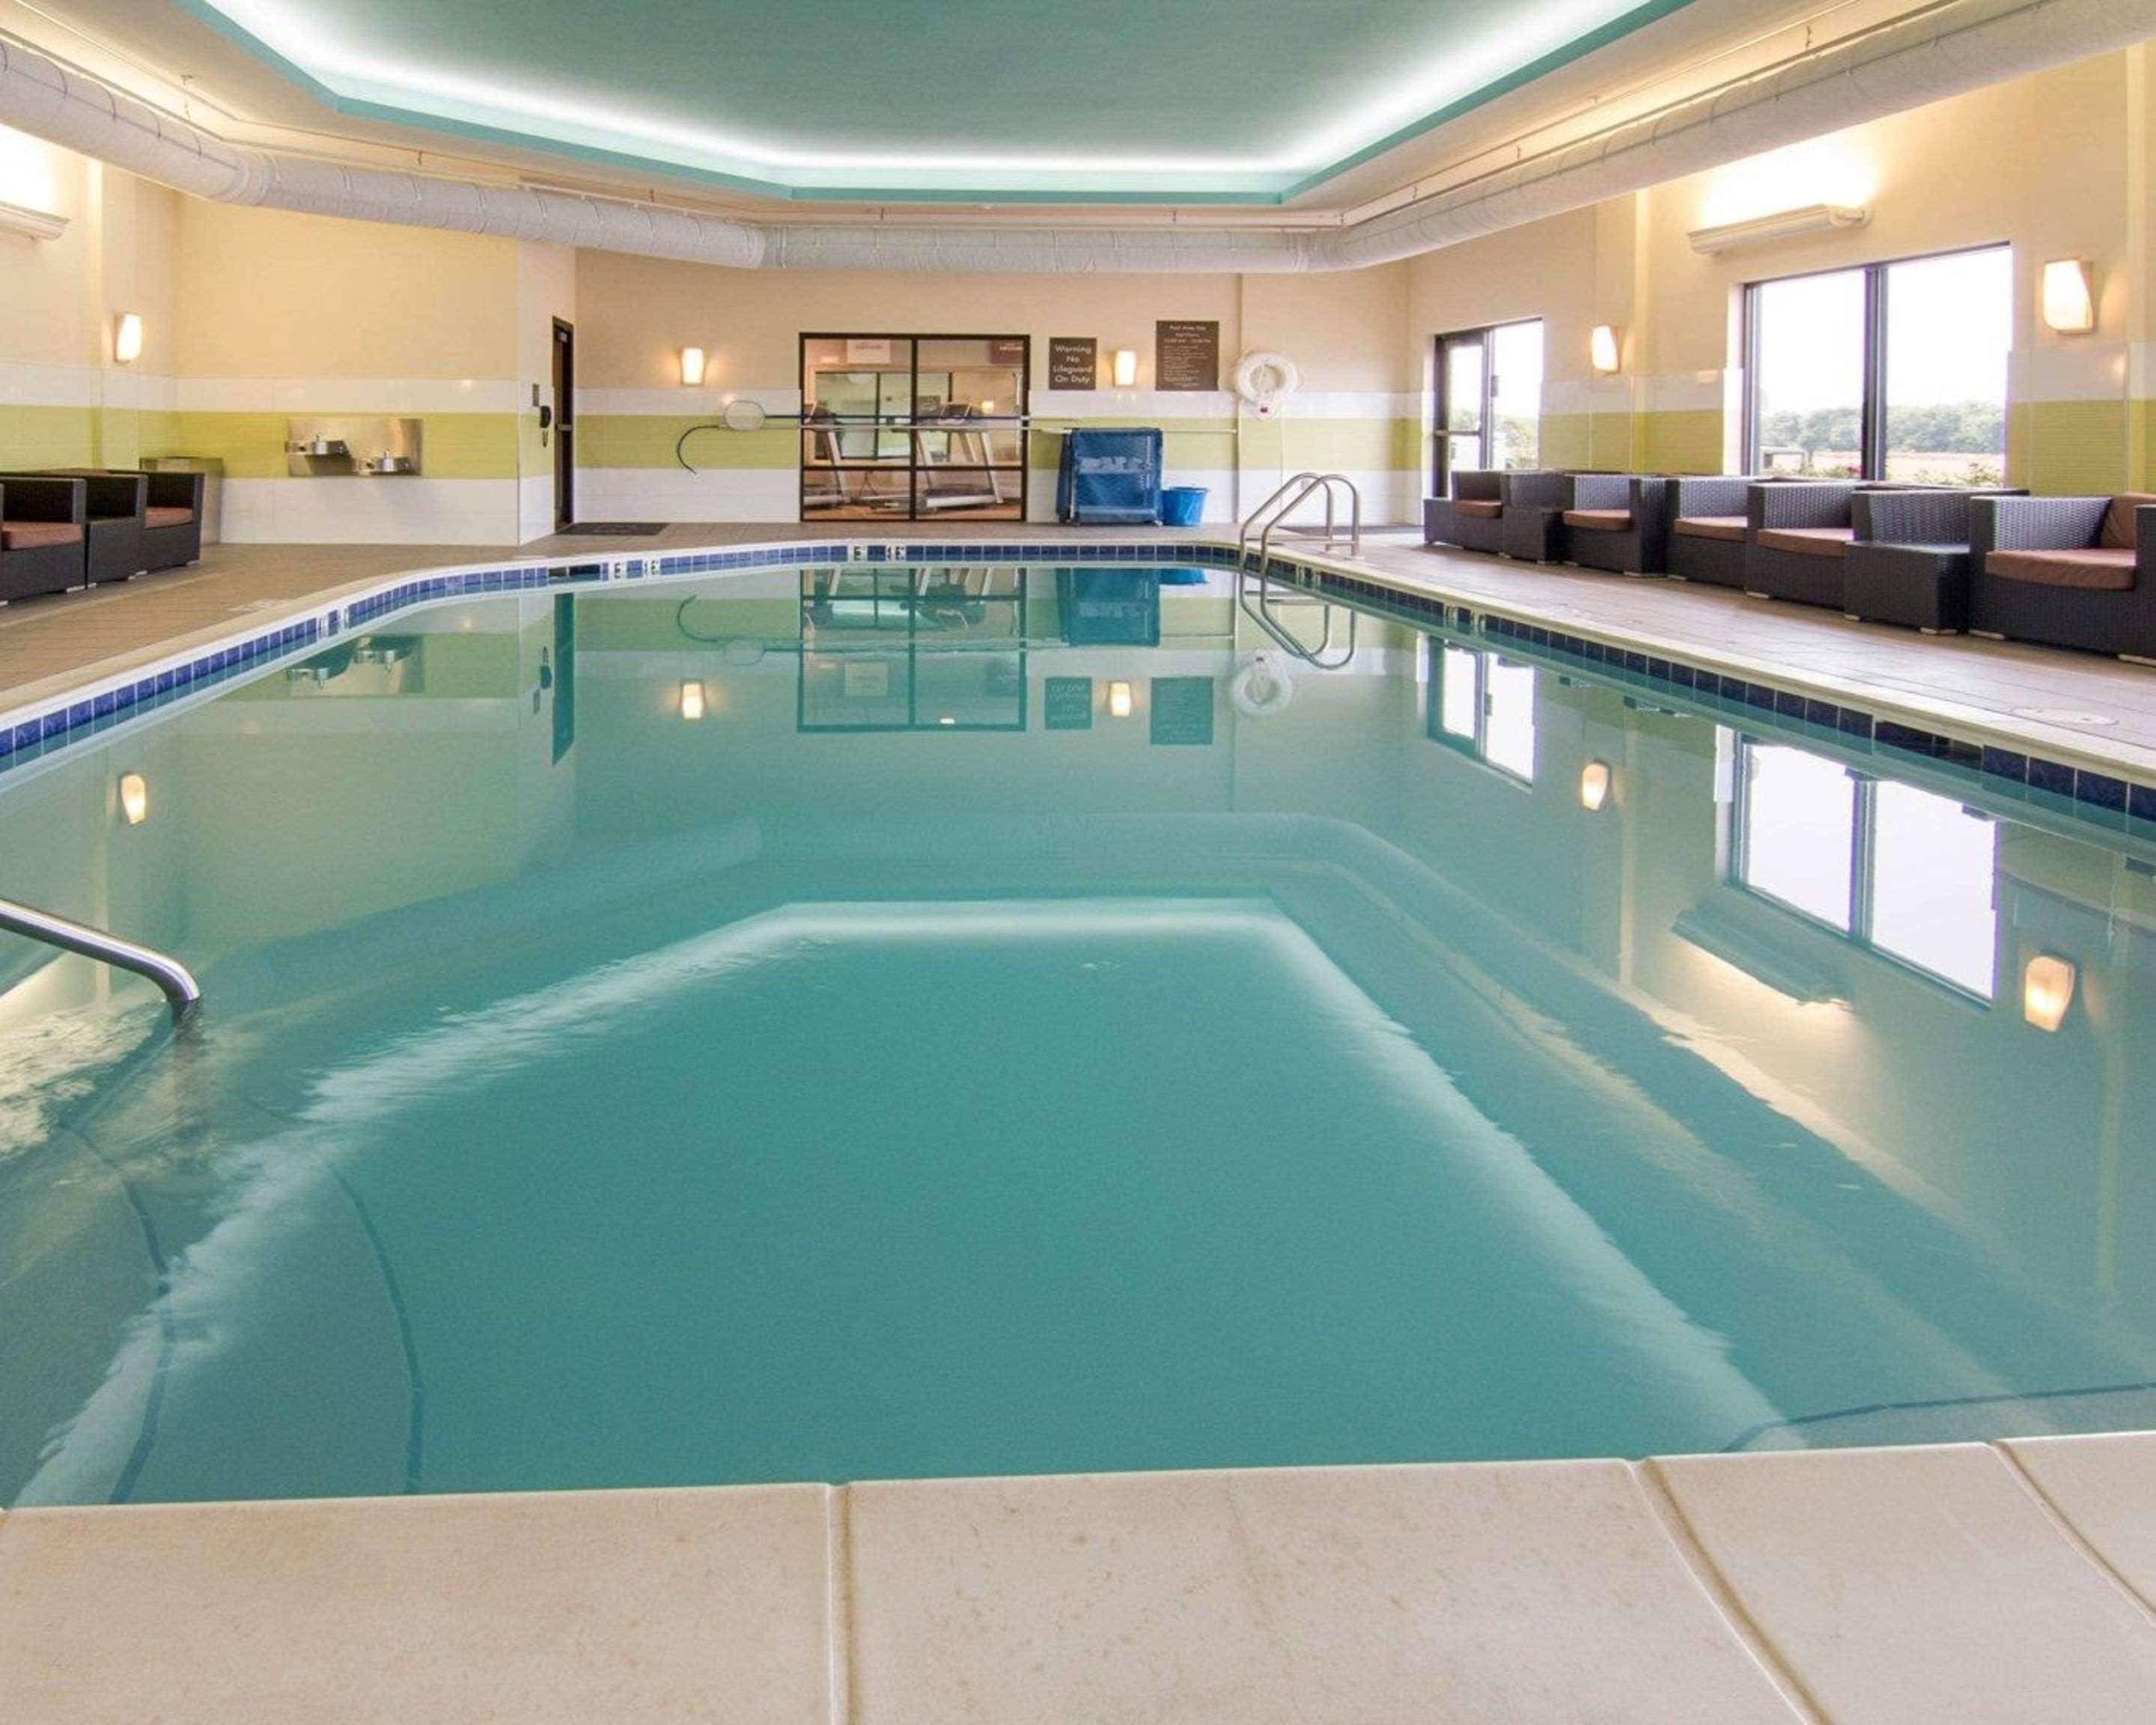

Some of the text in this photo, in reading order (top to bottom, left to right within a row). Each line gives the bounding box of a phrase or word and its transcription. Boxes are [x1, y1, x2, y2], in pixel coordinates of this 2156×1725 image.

[1054, 344, 1091, 355] Warning
[1053, 365, 1093, 374] Lifeguard
[1071, 374, 1091, 384] Duty
